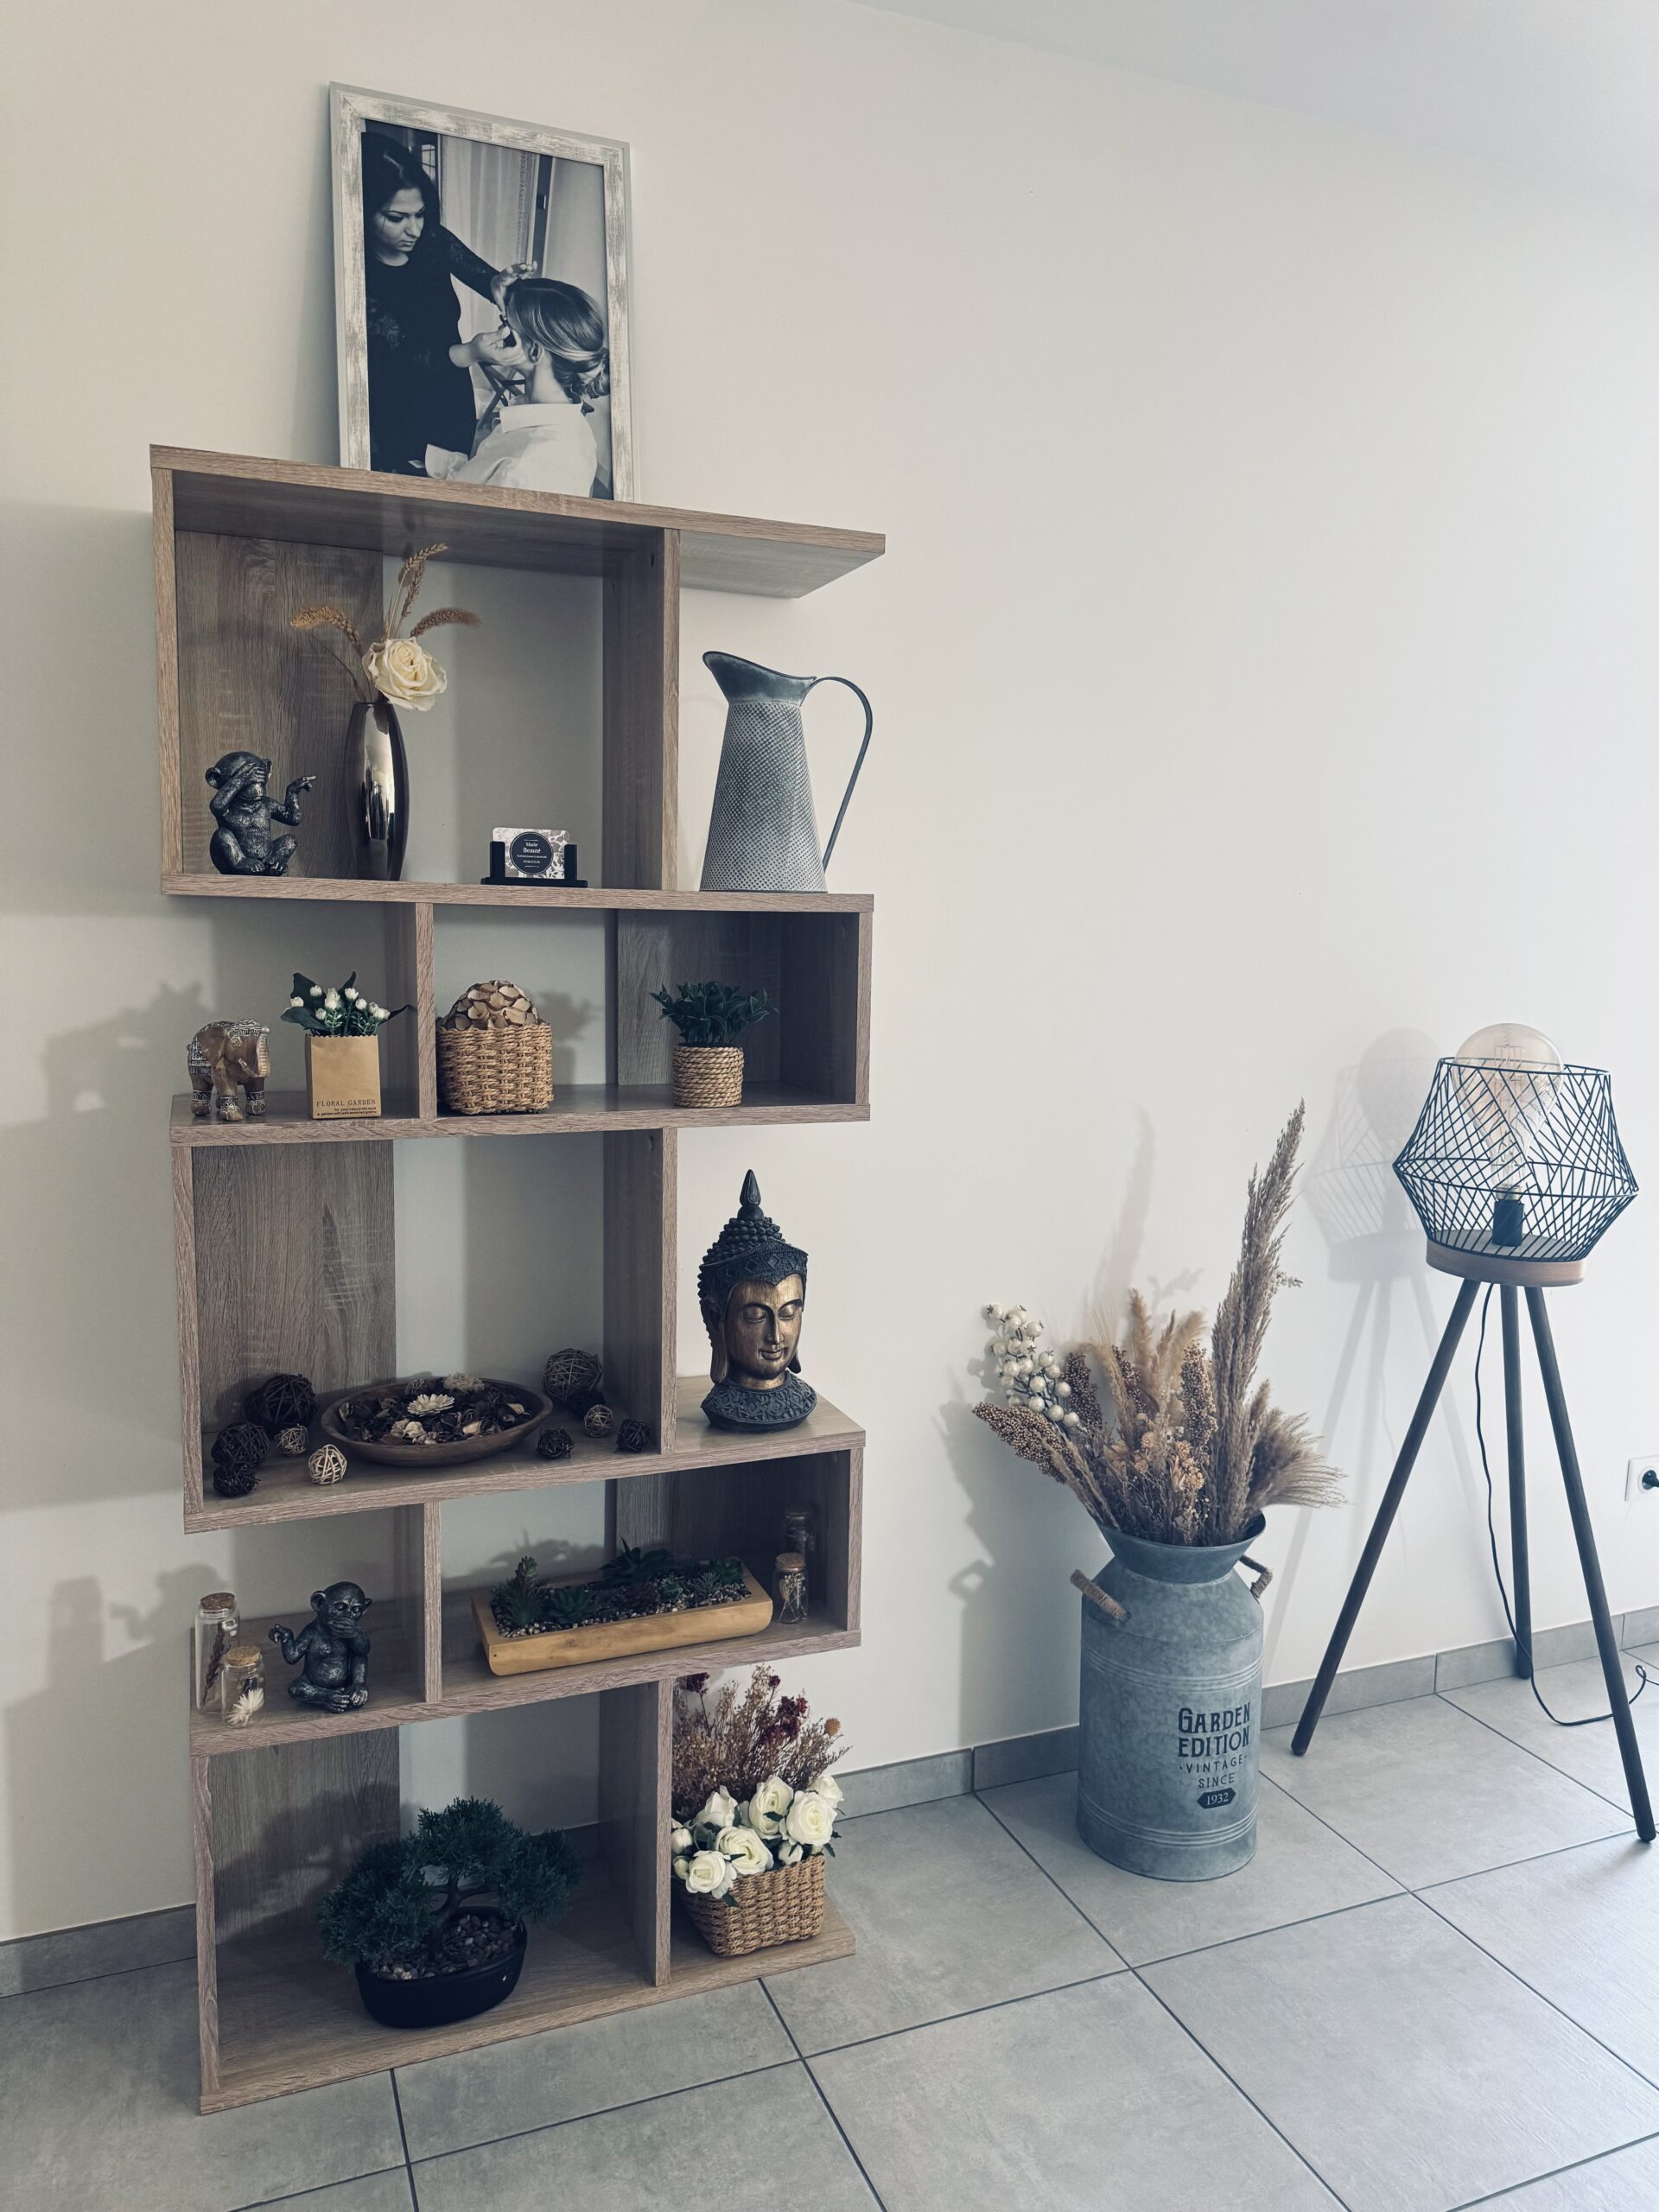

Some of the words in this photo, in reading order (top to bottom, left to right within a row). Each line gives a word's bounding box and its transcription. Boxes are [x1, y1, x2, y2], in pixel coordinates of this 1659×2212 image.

[1178, 1701, 1250, 1733] GARDEN
[1178, 1726, 1249, 1758] EDITION
[1198, 1772, 1235, 1789] SINCE
[1206, 1792, 1229, 1805] 1932
